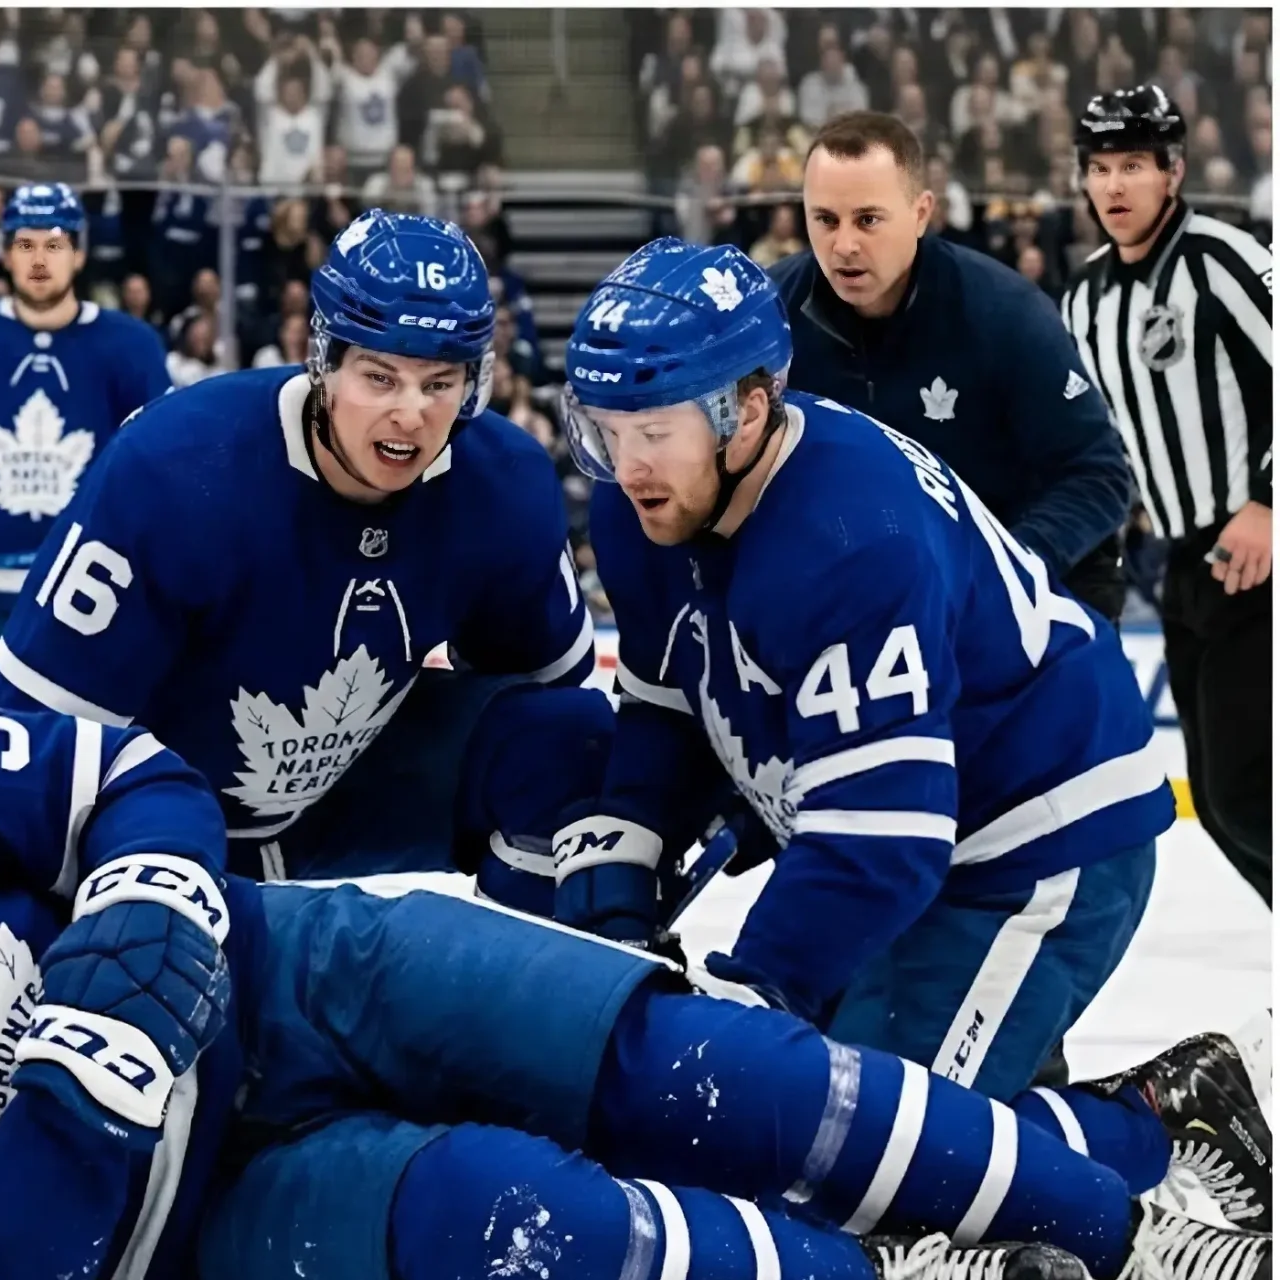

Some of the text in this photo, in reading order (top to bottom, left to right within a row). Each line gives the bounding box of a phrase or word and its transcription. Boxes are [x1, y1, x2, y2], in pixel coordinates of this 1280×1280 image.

[416, 261, 446, 291] 16
[588, 299, 631, 333] 44
[35, 521, 134, 636] 16
[796, 624, 929, 734] 44
[86, 864, 222, 928] CCM
